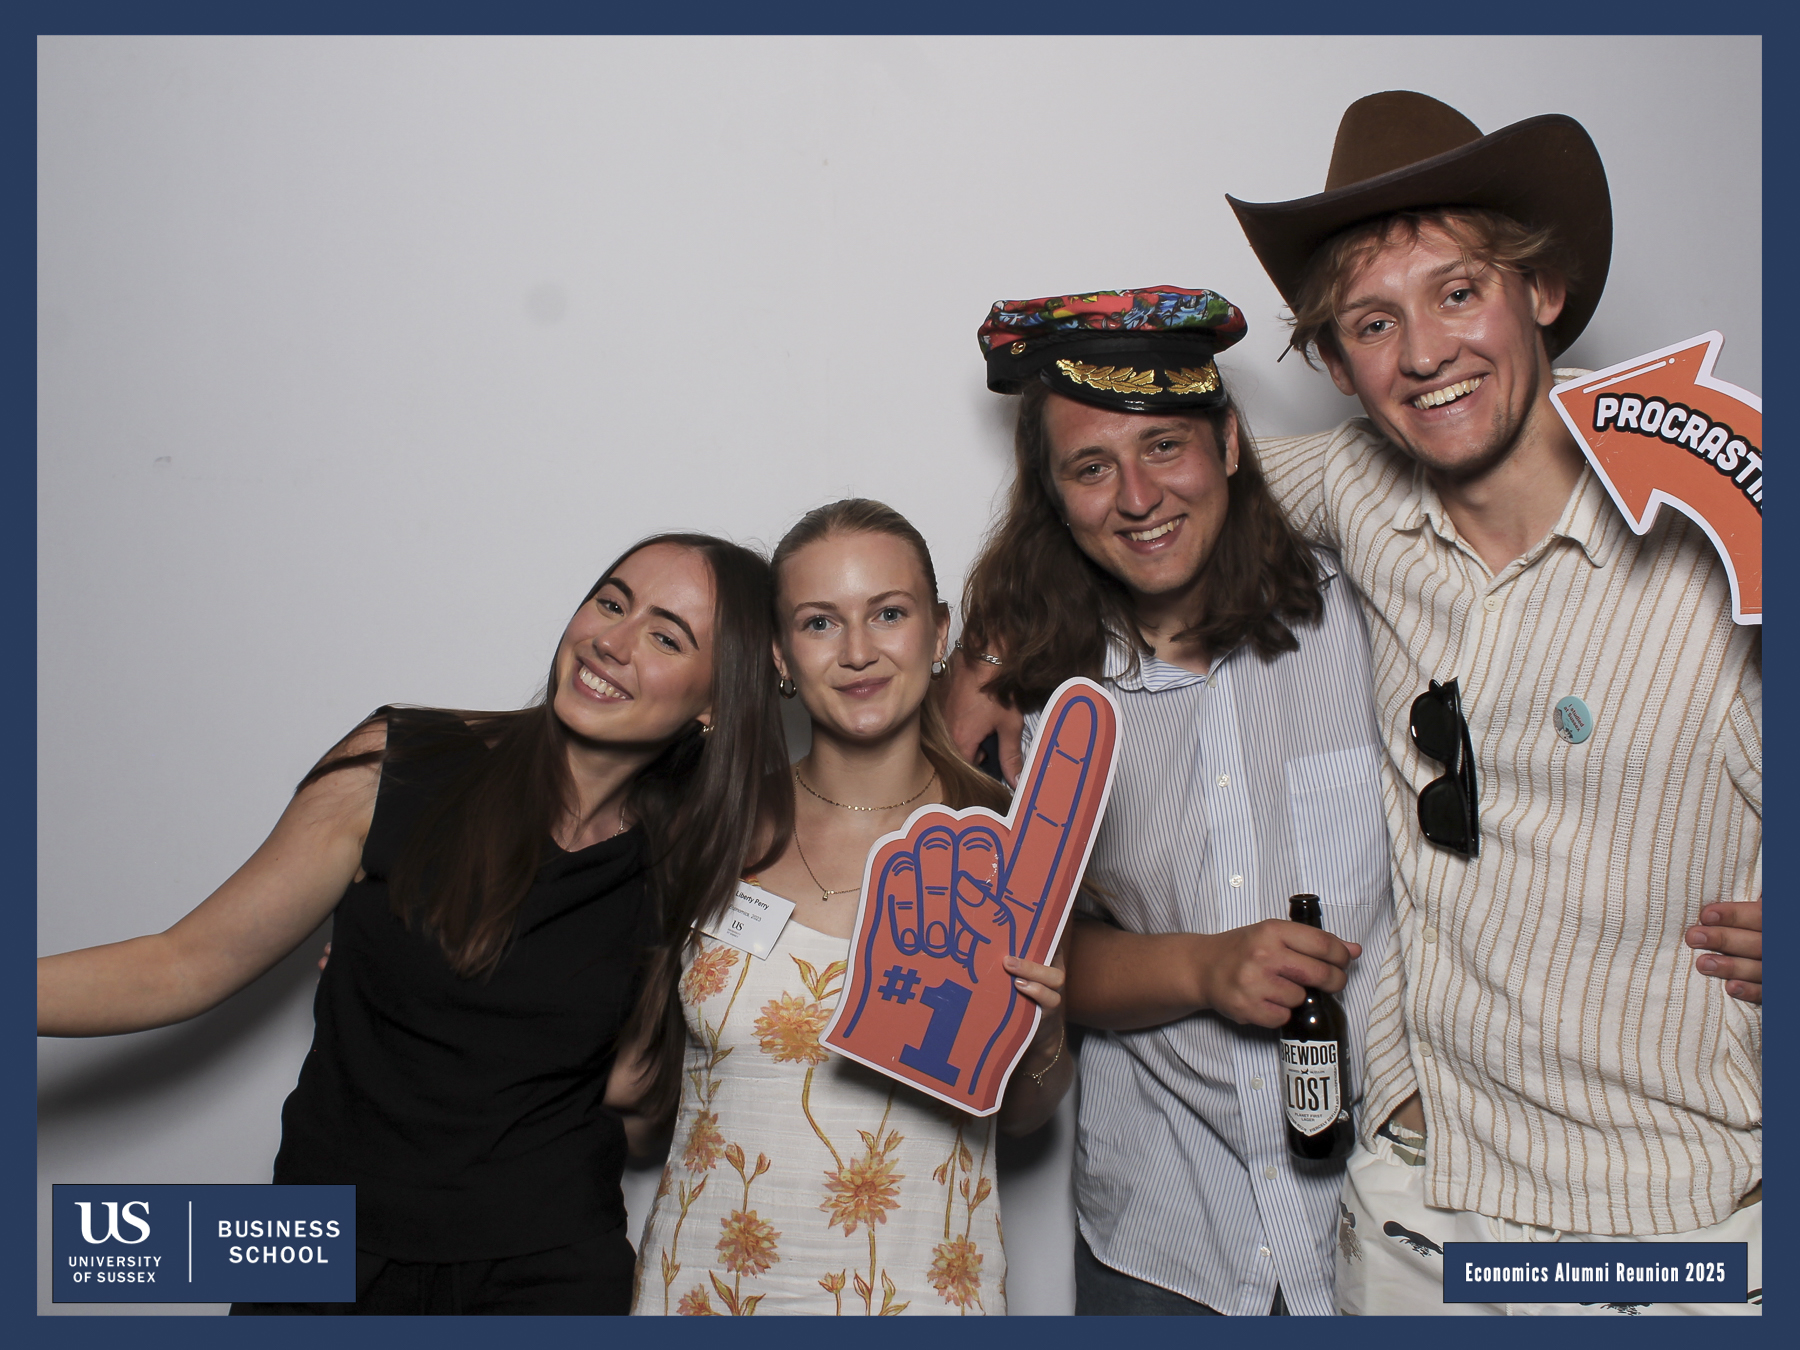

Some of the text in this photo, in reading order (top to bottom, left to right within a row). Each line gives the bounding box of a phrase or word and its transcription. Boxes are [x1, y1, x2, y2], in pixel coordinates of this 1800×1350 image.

[1594, 395, 1762, 511] PROCRASTI
[735, 890, 769, 910] Liberty Perry
[1286, 1073, 1331, 1111] LOST
